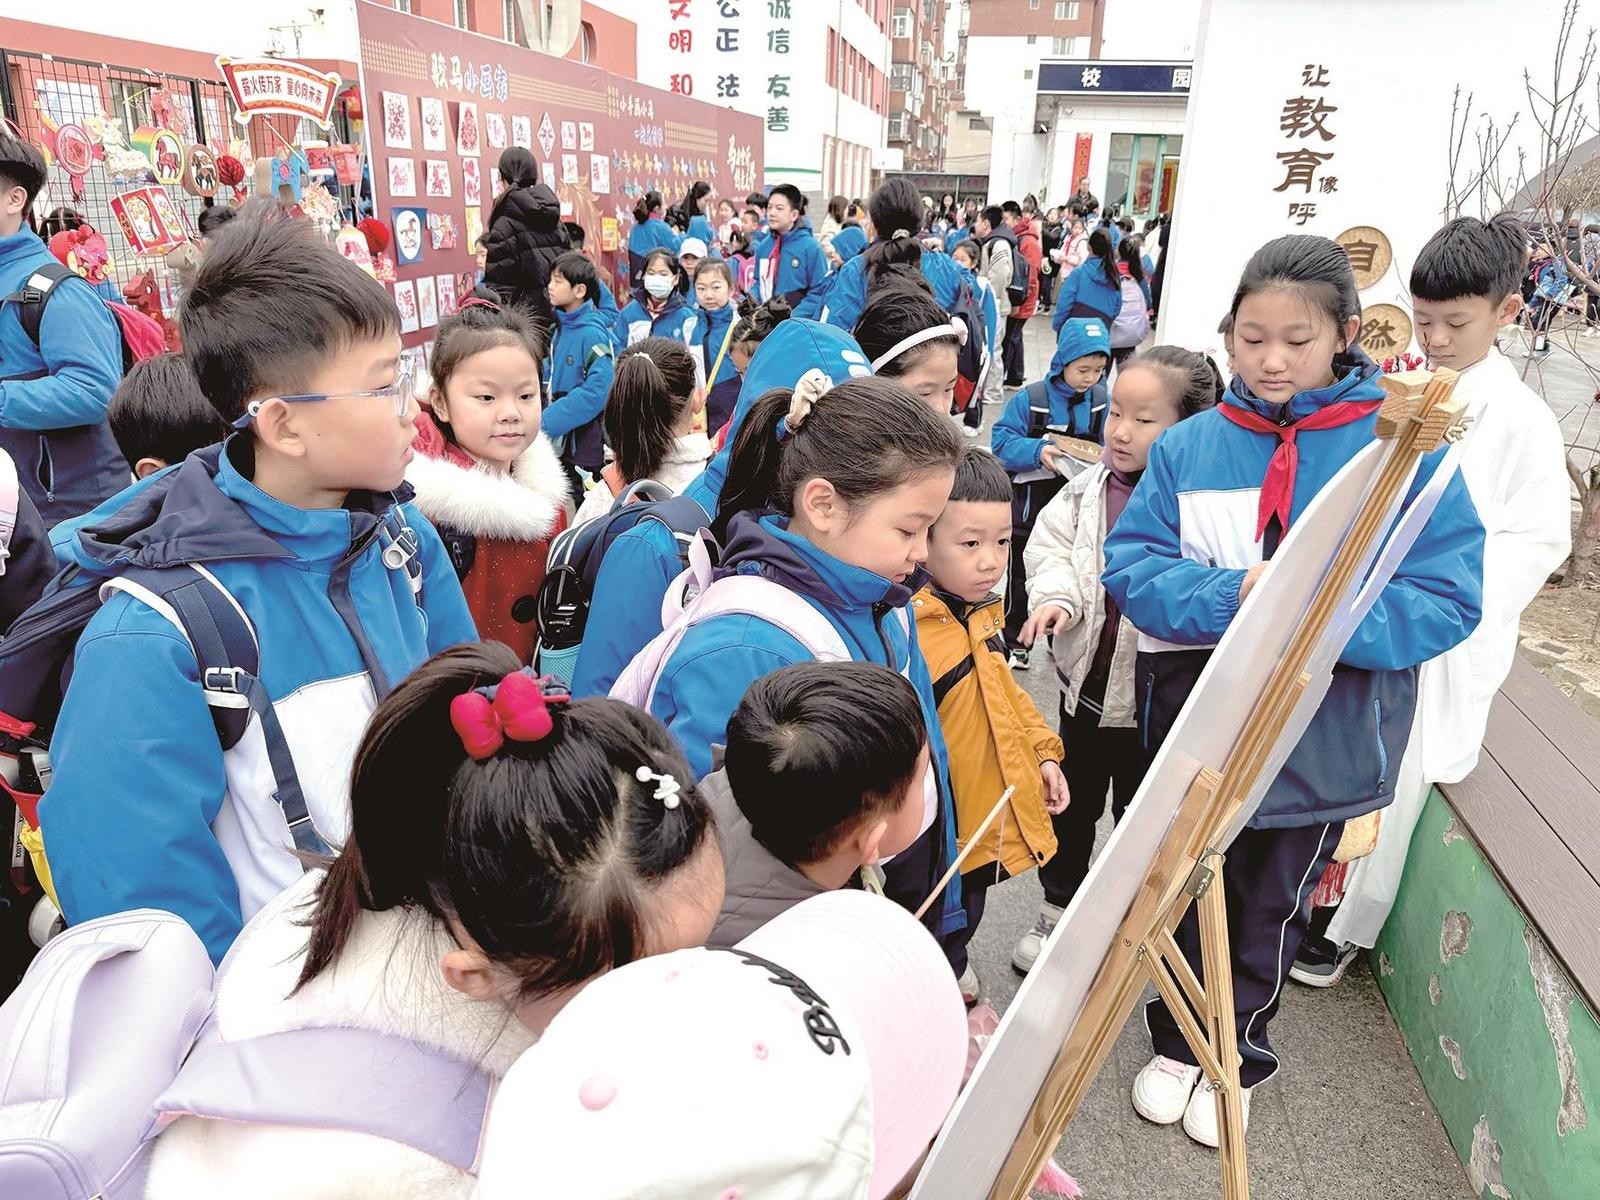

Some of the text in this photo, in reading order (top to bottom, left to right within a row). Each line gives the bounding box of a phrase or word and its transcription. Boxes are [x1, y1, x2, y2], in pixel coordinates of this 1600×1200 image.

[669, 0, 693, 96] 文明 和
[767, 0, 791, 132] 诚信 友善
[241, 75, 323, 106] 薪火传万家 童心向未来
[430, 51, 508, 103] 骏马小画家
[716, 73, 740, 110] 法
